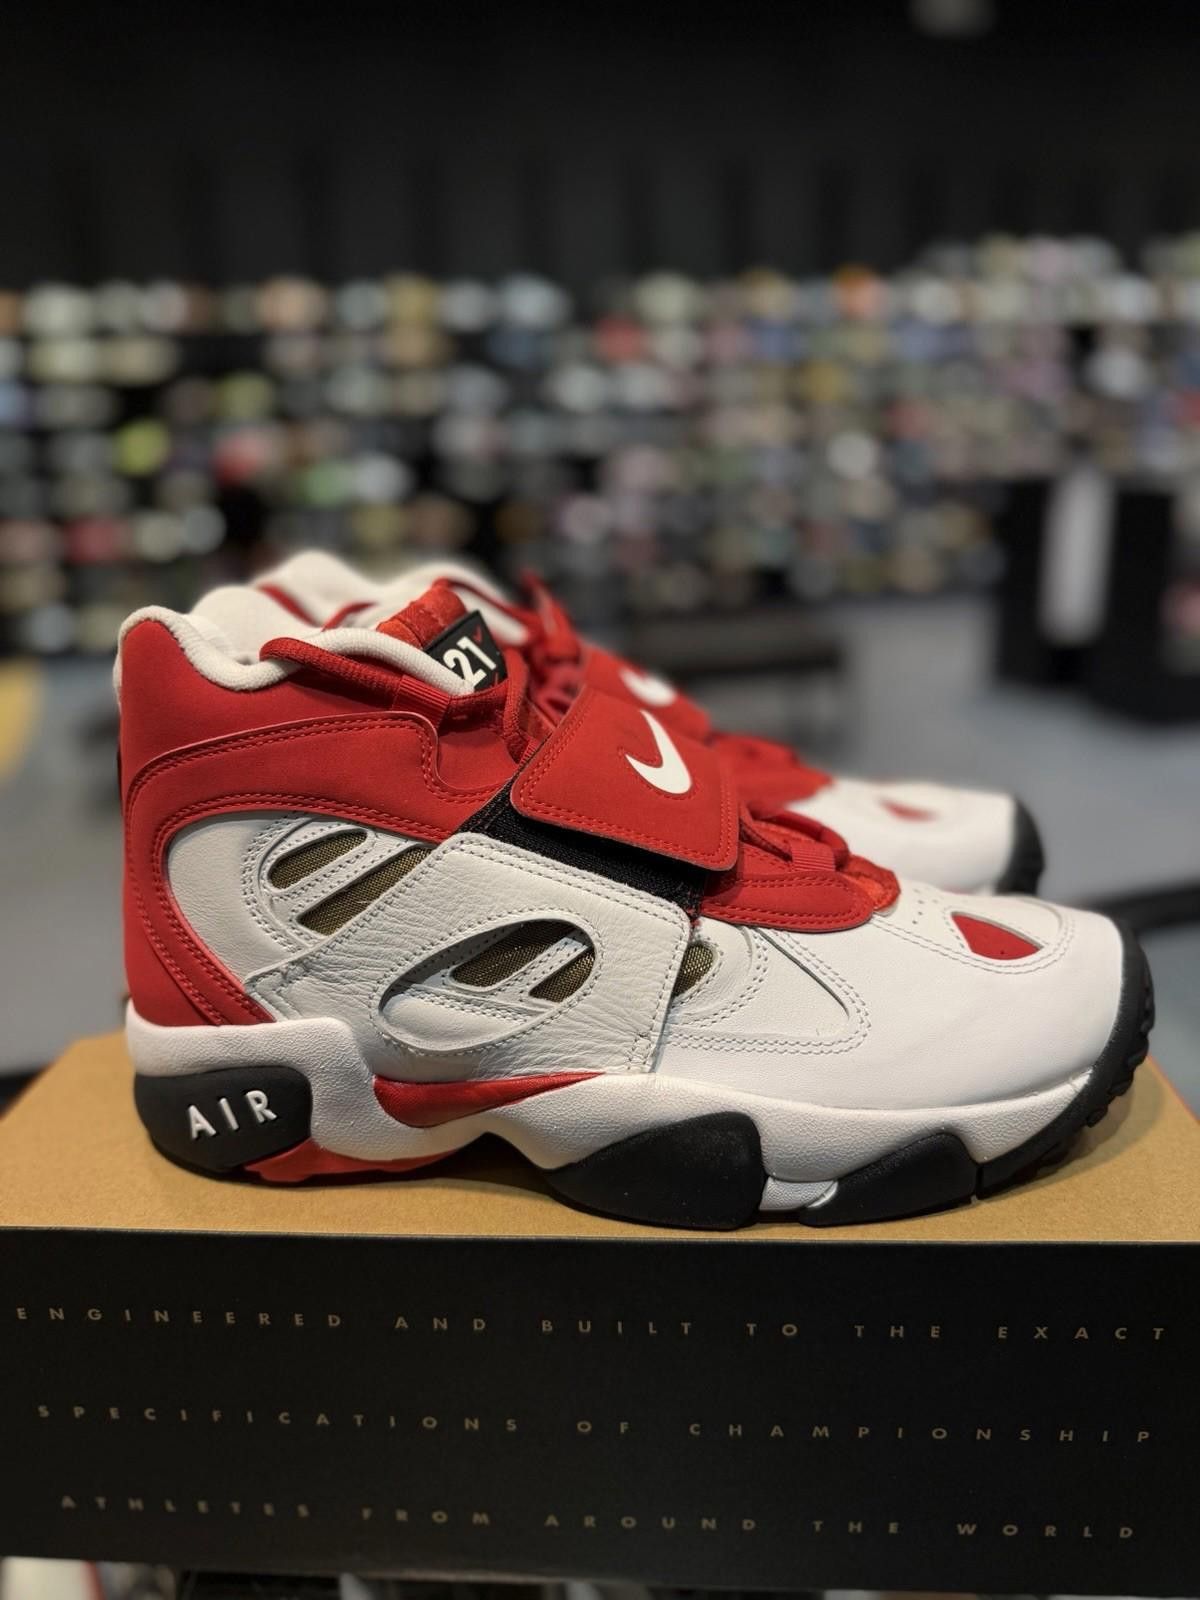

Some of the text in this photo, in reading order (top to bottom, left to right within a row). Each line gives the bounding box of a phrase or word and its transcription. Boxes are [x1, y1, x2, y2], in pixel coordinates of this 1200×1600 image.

[443, 636, 497, 687] 21
[188, 1089, 278, 1139] AIR
[16, 1307, 1165, 1341] ENGINEERED AND BUILT TO THE EXACT
[38, 1404, 1150, 1443] SPECIFICATIONS OF CHAMPIONSHIP
[62, 1495, 1133, 1539] ATHLETES FROM AROUND THE WORLD
